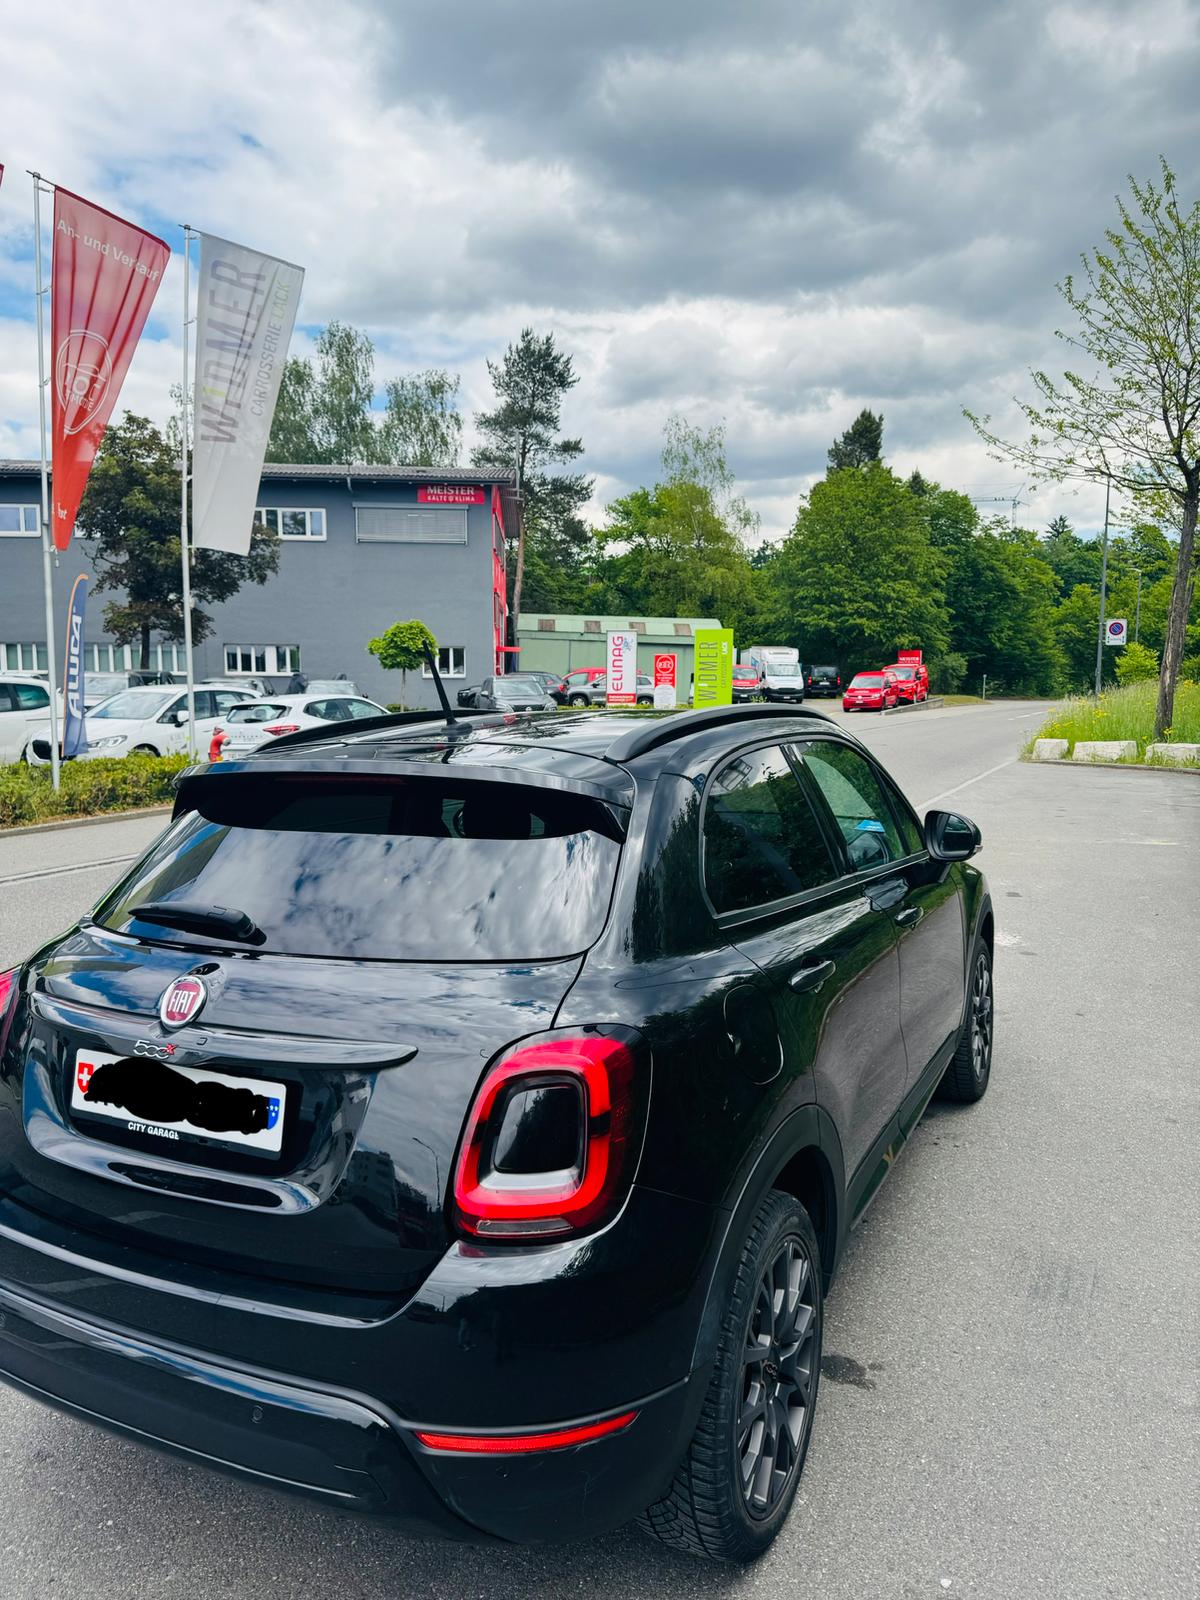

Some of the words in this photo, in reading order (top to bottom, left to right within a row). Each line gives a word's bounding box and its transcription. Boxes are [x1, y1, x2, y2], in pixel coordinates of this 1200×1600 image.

[57, 219, 81, 240] An-
[83, 235, 111, 256] und
[250, 322, 283, 418] CARROSSERIE
[428, 486, 474, 495] MEISTER
[68, 615, 82, 719] ALUCA
[612, 635, 624, 692] ELINAG
[697, 641, 718, 701] WIDMER
[168, 989, 195, 1014] FIAT
[127, 1121, 146, 1134] CITY
